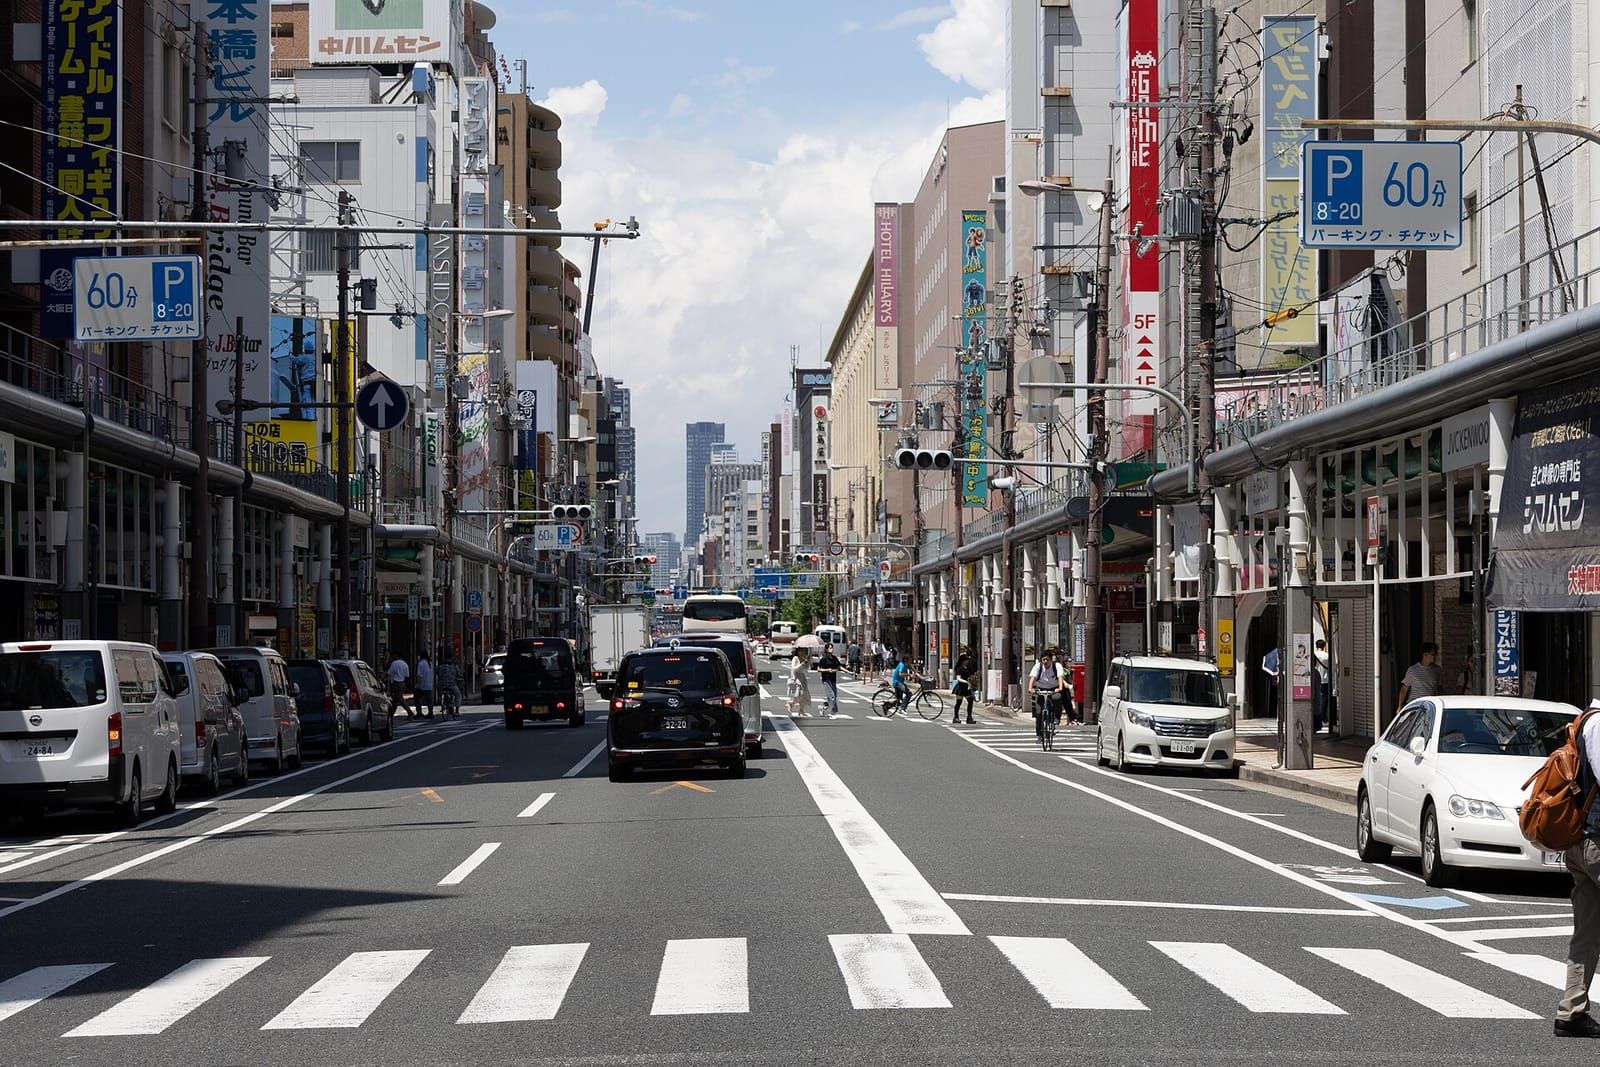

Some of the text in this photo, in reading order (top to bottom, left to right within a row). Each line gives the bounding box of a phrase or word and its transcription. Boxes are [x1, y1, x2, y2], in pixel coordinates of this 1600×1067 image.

[319, 35, 440, 55] 中川ムセン
[1327, 155, 1353, 197] P
[1383, 162, 1447, 208] 60分
[1316, 202, 1361, 220] 8-20
[881, 222, 892, 263] HOTEL
[1311, 229, 1455, 242] パーキング・チケット
[88, 273, 138, 309] 60分
[164, 266, 185, 299] P
[157, 303, 192, 318] 8-20
[81, 324, 195, 337] パーキング・チケット
[1134, 314, 1156, 329] 5F
[206, 357, 259, 372] ロダクョン
[1523, 490, 1585, 534] シマムセン
